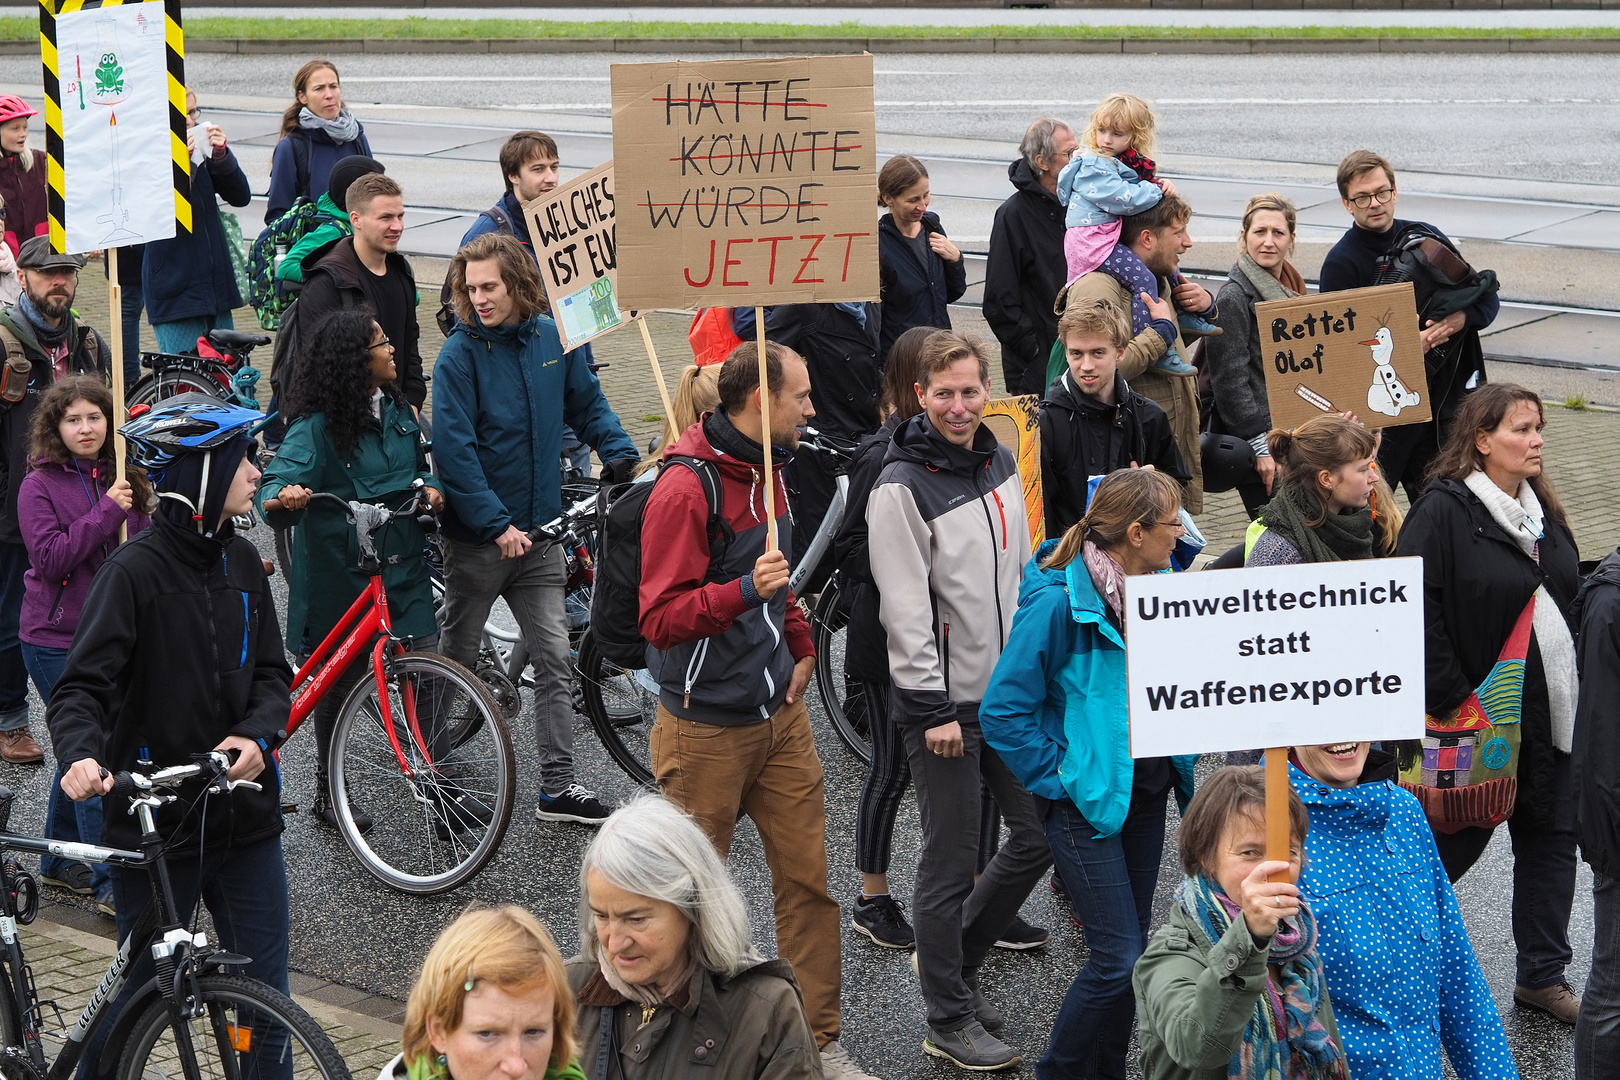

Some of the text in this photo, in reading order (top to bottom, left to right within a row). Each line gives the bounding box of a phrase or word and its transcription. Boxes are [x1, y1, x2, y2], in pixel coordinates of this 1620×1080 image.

[666, 78, 810, 126] HÄTTE
[682, 131, 860, 176] KÖNNTE
[534, 176, 616, 248] WELCHES
[647, 183, 824, 229] WÜRDE
[548, 223, 617, 287] IST EU
[684, 233, 870, 288] JETZT
[592, 278, 612, 299] 100
[1272, 307, 1357, 342] Rettet
[1275, 344, 1324, 375] Olaf
[1138, 580, 1408, 621] Umwelttechnick
[1238, 630, 1311, 657] statt
[1146, 670, 1402, 712] Waffenexporte
[78, 950, 127, 1030] WHEELER
